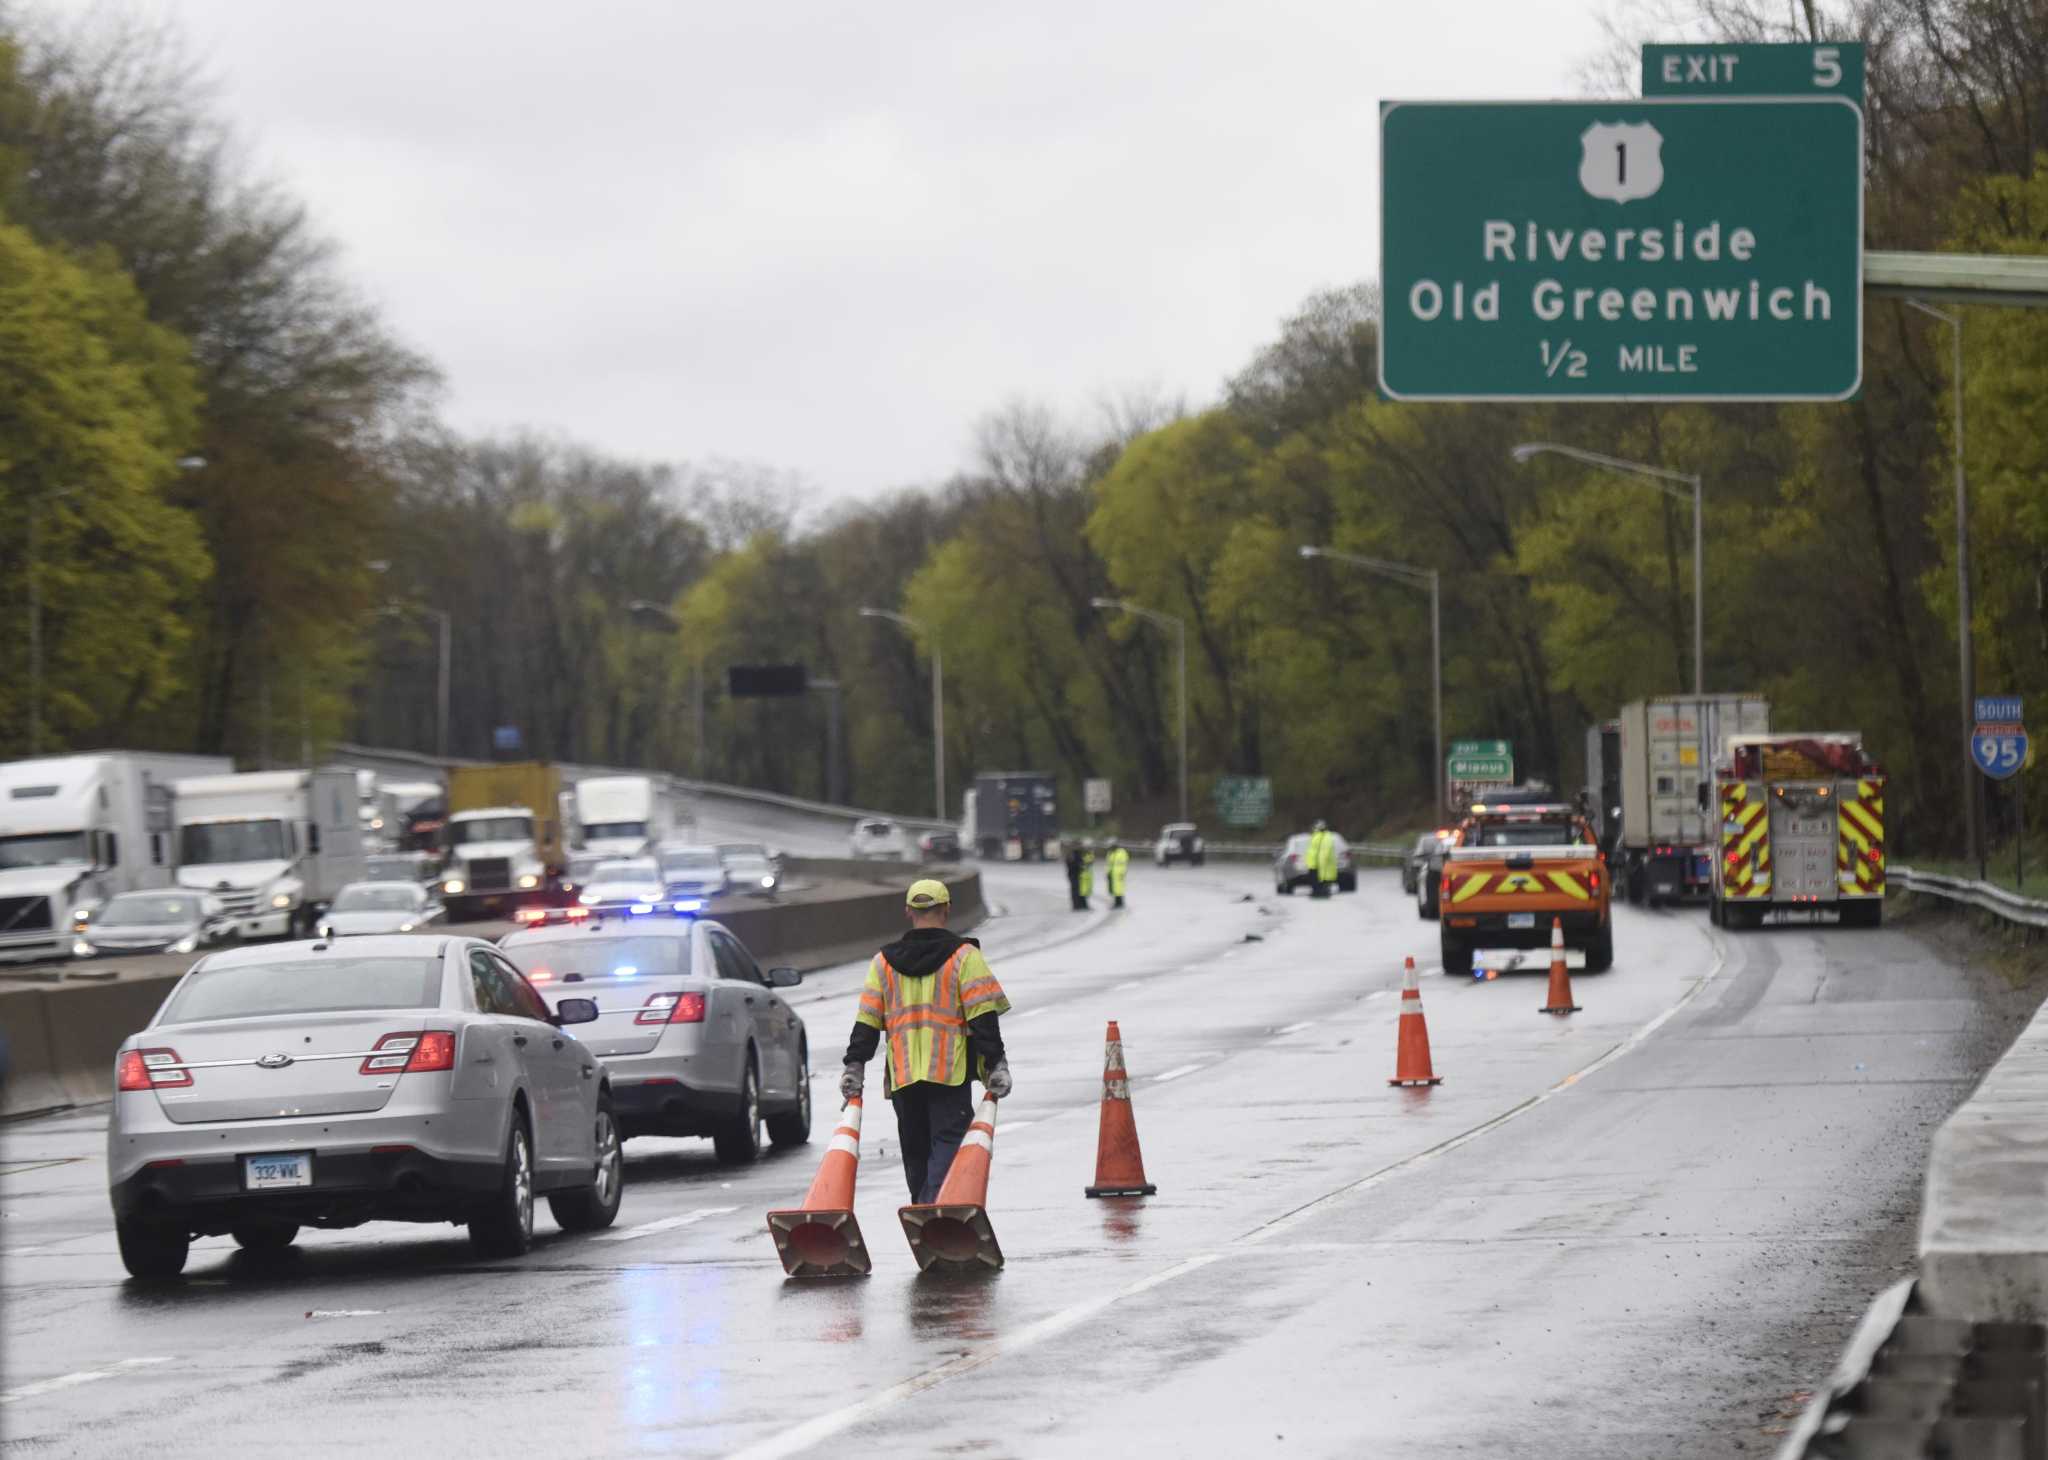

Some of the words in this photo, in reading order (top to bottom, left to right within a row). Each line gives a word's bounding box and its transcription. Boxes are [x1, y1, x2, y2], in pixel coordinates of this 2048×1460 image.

[1662, 55, 1739, 83] EXIT
[1812, 47, 1843, 88] 5
[1616, 142, 1626, 185] 1
[1484, 221, 1756, 261] Riverside
[1409, 280, 1500, 321] Old
[1532, 280, 1832, 321] Greenwich
[1619, 344, 1698, 372] MILE
[1978, 703, 2021, 720] SOUTH
[1981, 736, 2018, 768] 95
